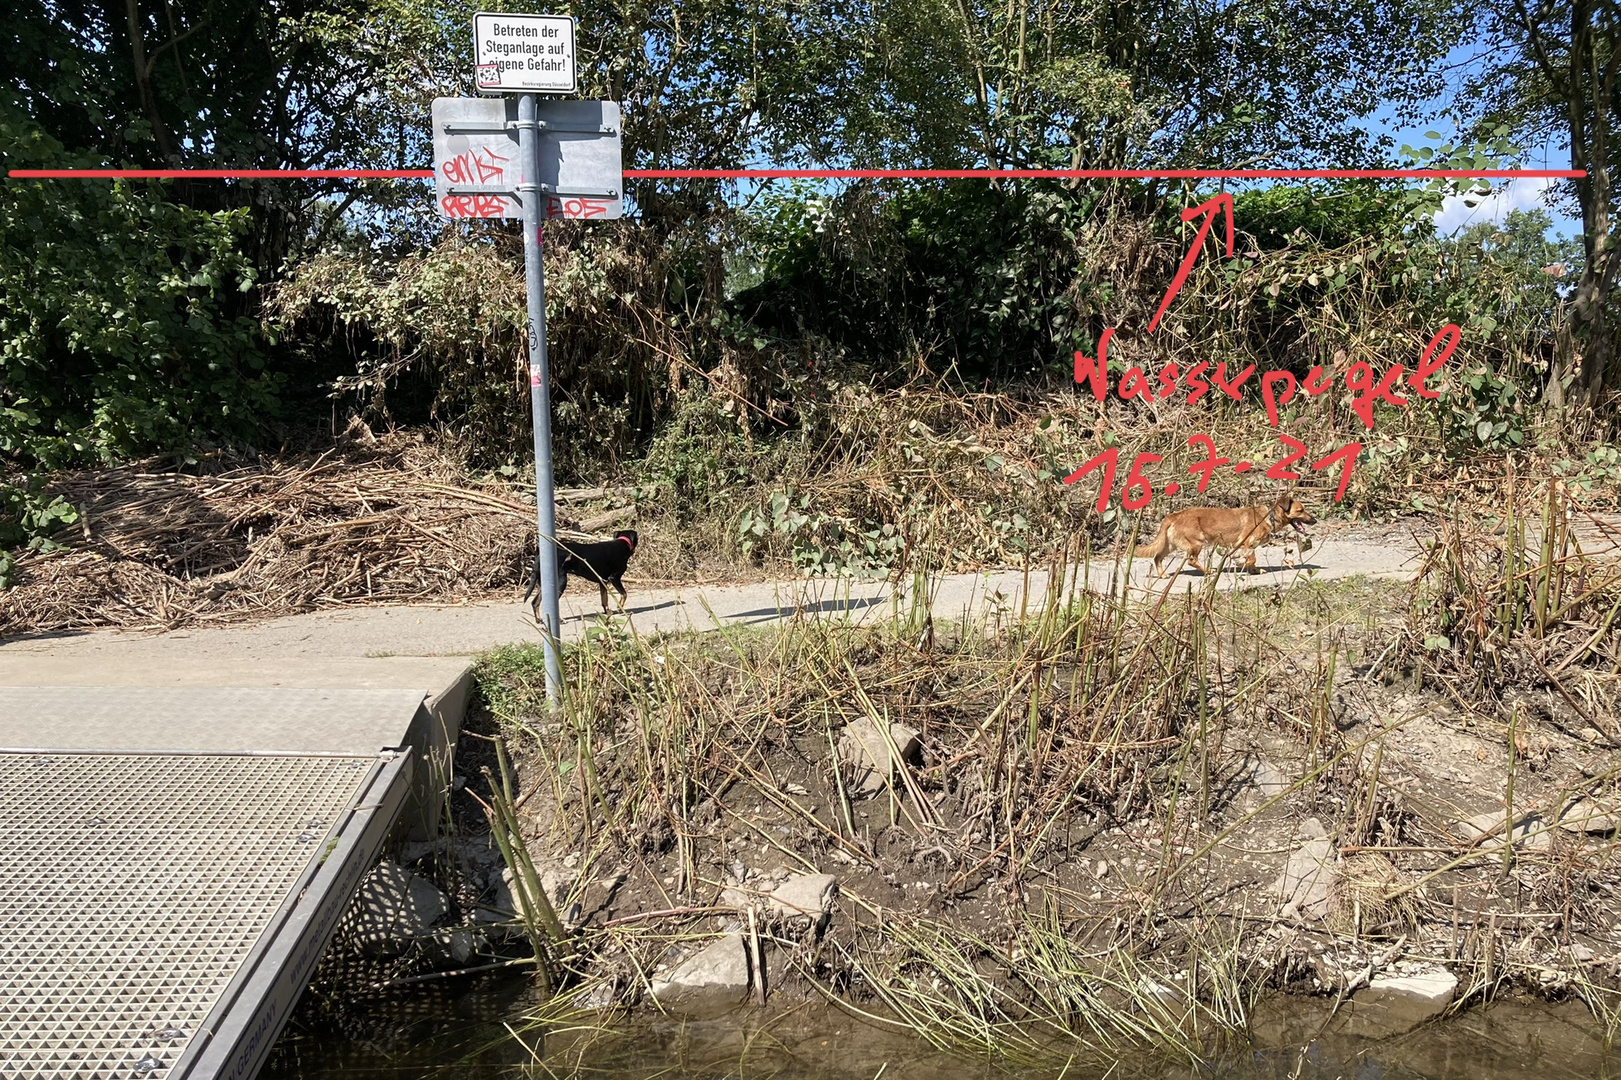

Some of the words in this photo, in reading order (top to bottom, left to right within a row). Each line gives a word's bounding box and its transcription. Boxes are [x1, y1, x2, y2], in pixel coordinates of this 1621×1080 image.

[493, 23, 538, 38] Betreten
[541, 24, 559, 38] der
[486, 40, 544, 57] Steganlage
[547, 42, 565, 55] auf
[527, 57, 566, 72] Gefahr!
[237, 998, 277, 1076] GERMANY
